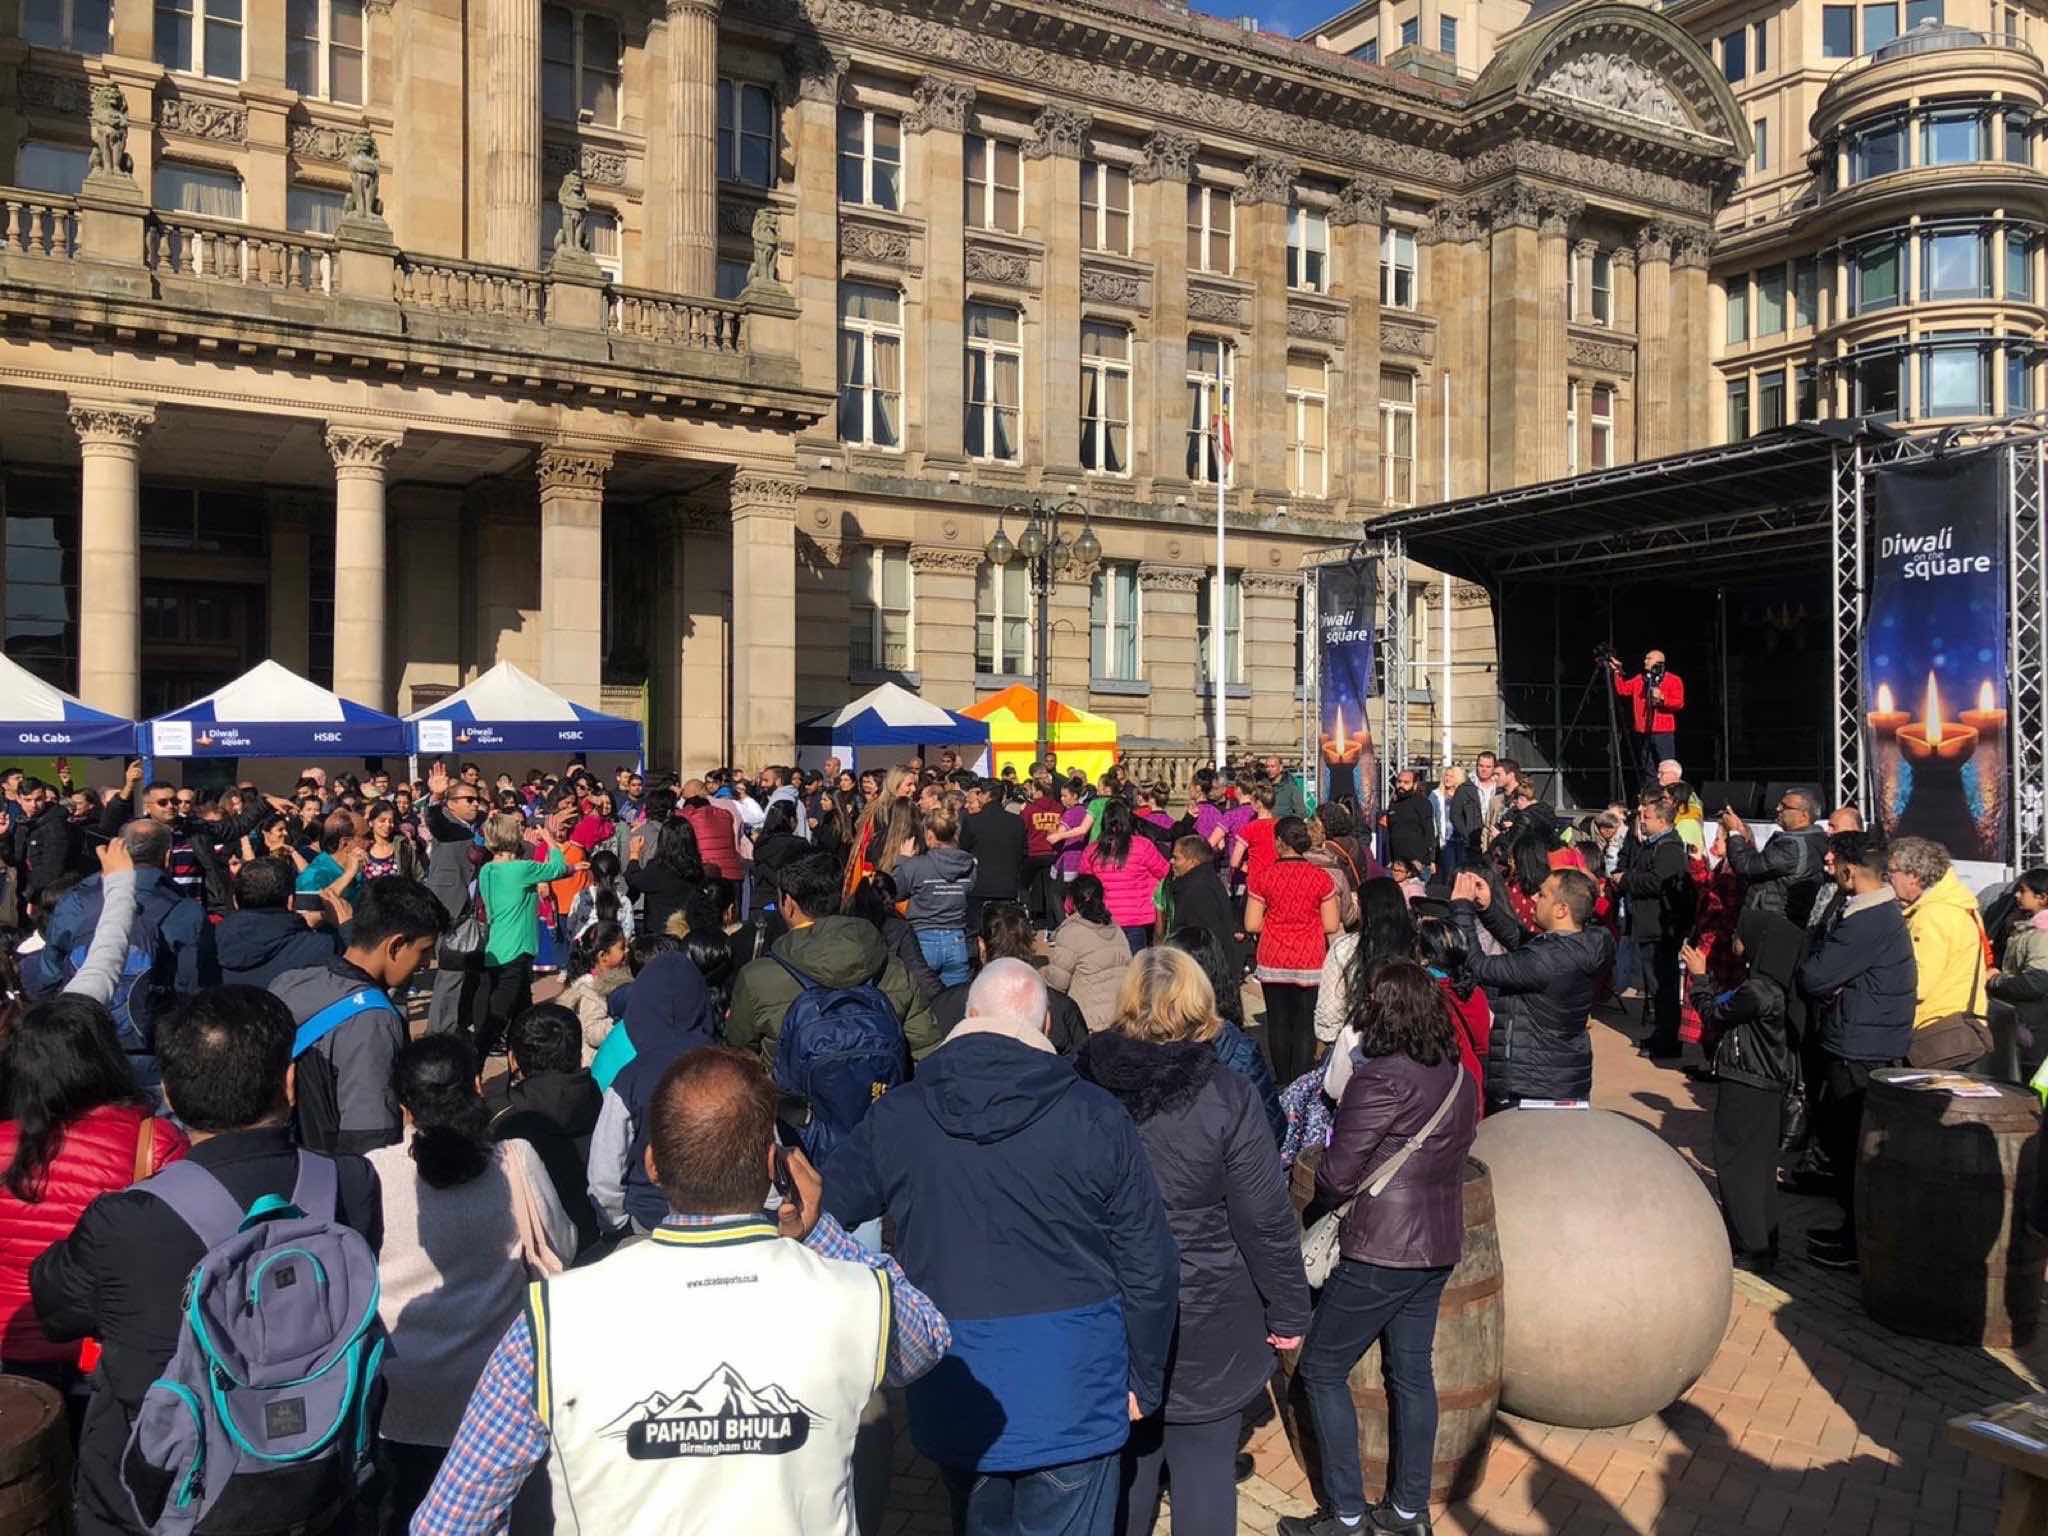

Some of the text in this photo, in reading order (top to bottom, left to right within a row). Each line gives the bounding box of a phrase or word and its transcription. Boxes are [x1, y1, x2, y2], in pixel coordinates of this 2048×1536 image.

[1881, 526, 1953, 558] Diwali
[1913, 551, 1945, 562] on the
[1904, 555, 1991, 581] square
[1326, 629, 1368, 646] square
[209, 728, 239, 738] Diwali
[313, 732, 342, 742] HSBC
[466, 727, 494, 736] Diwali
[558, 731, 584, 741] HSBC
[18, 732, 71, 743] Ola Cabs
[221, 738, 251, 747] square
[645, 1416, 792, 1443] PAHADI BHULA
[680, 1440, 762, 1456] Birmingham U.K
